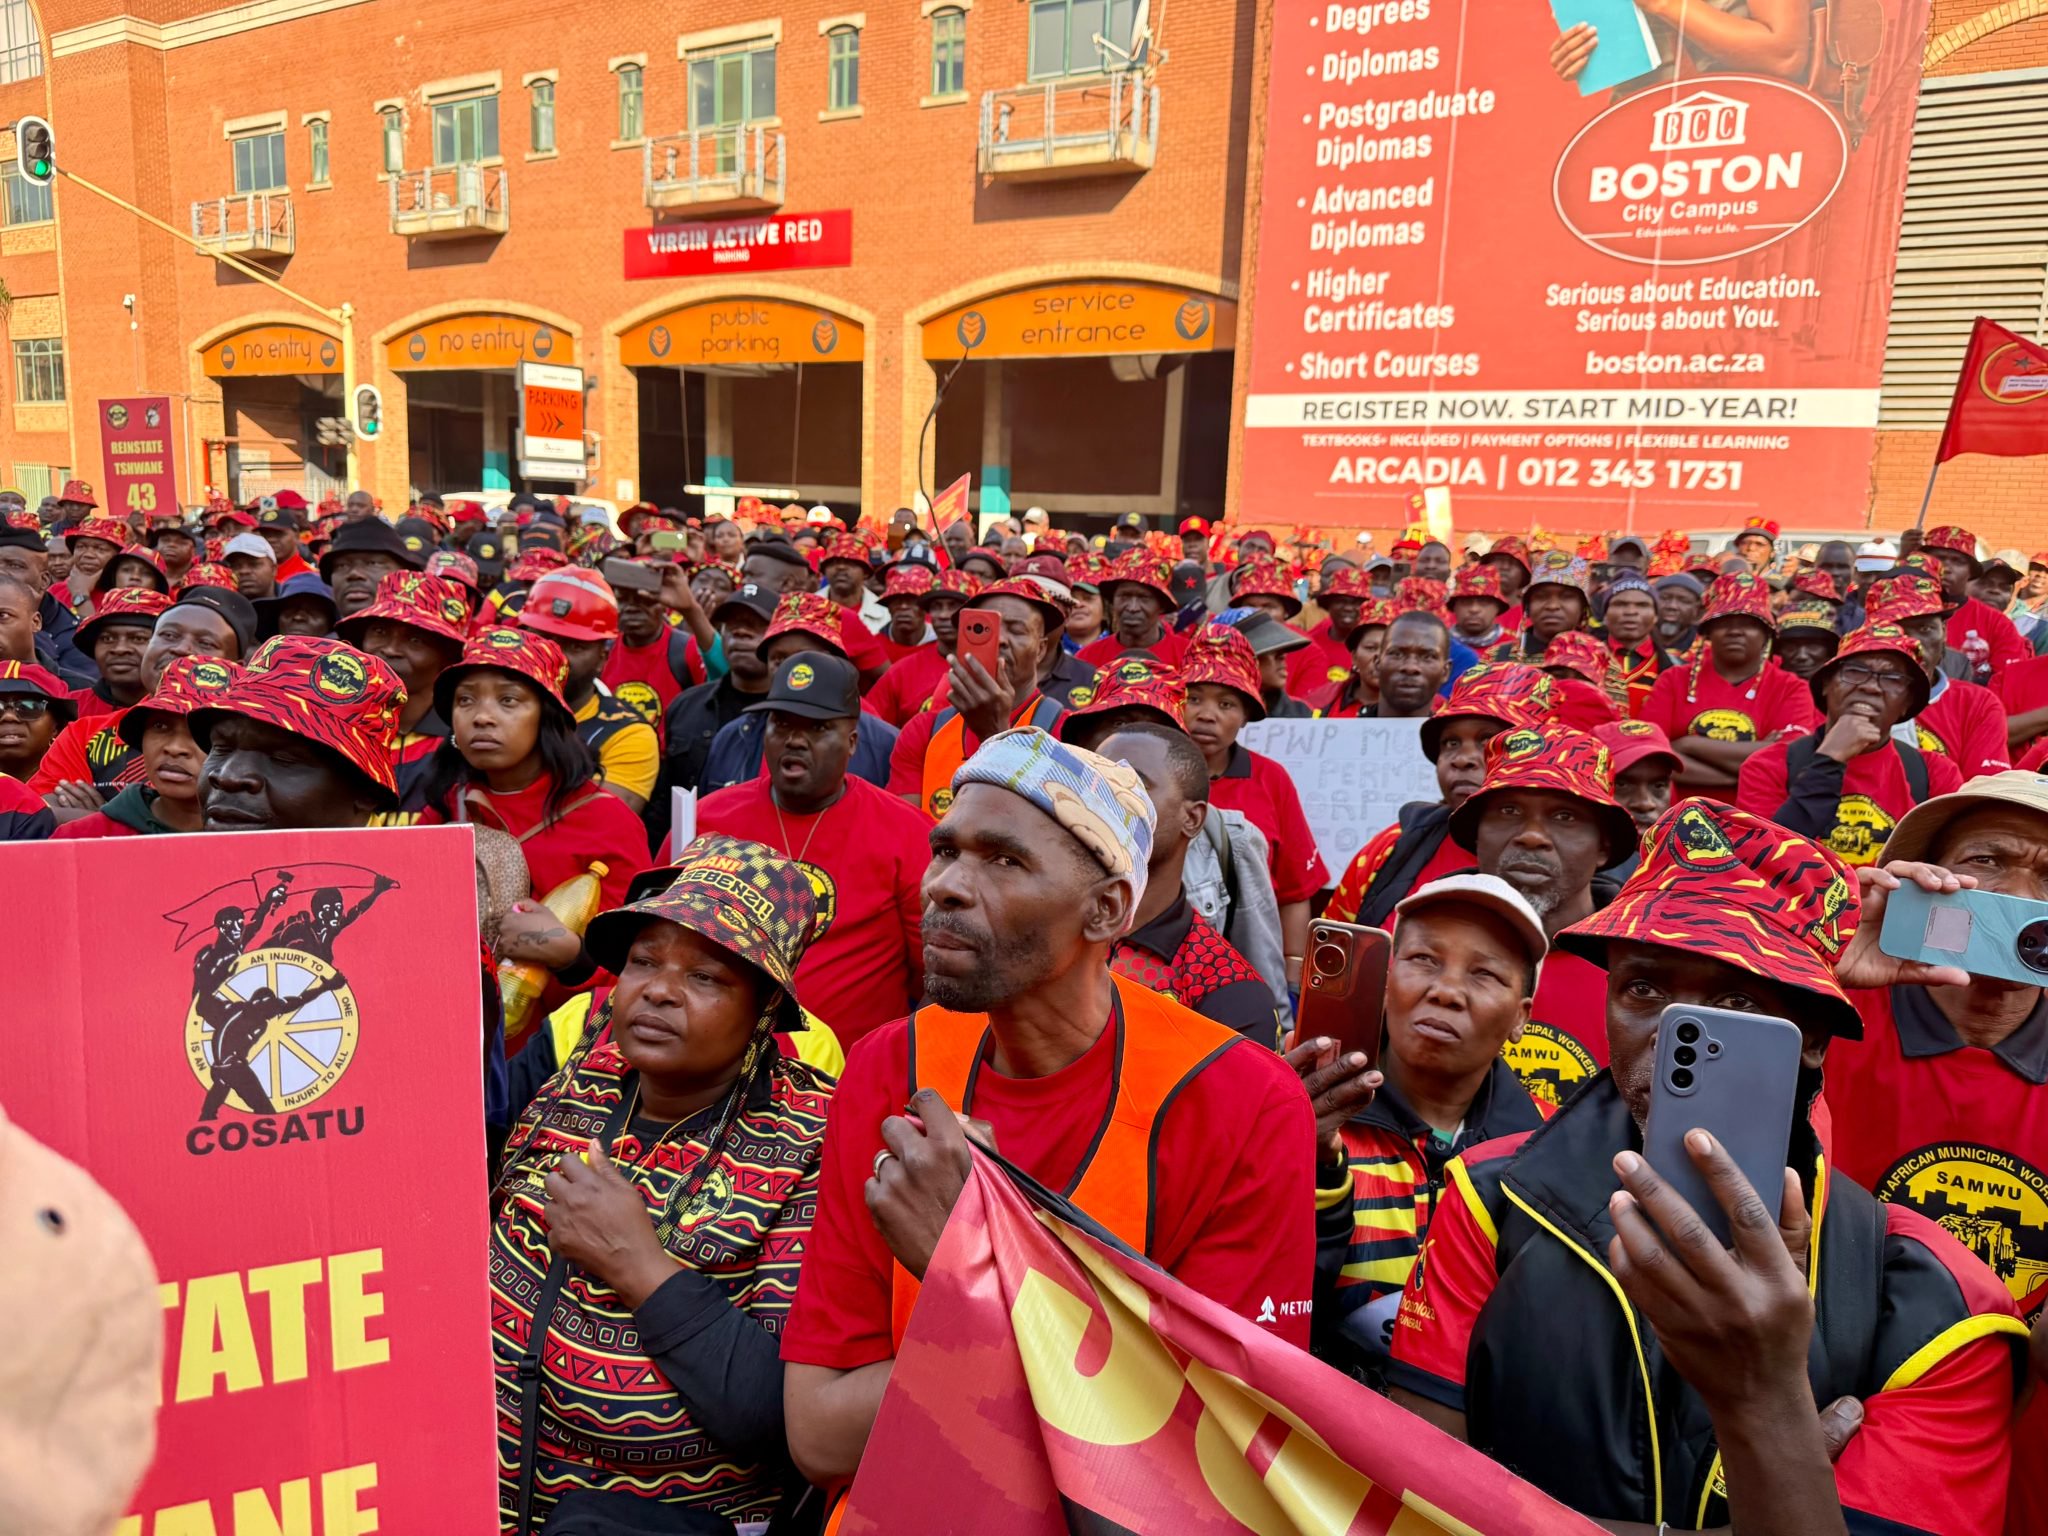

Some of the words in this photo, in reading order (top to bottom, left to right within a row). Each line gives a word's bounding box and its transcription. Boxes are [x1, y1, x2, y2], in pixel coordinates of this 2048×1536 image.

[1325, 0, 1431, 35] Degrees
[1322, 46, 1440, 86] Diplomas
[1319, 87, 1495, 131] Postgraduate
[1316, 134, 1433, 171] Diplomas
[1589, 151, 1803, 203] BOSTON
[1311, 176, 1434, 215] Advanced
[1622, 204, 1664, 224] City
[1670, 200, 1759, 220] Campus
[647, 229, 708, 254] VIRGIN
[713, 223, 780, 249] ACTIVE
[784, 219, 823, 244] RED
[1310, 219, 1425, 255] Diplomas
[713, 249, 750, 264] PARKING
[1306, 267, 1391, 303] Higher
[1545, 281, 1625, 307] Serious
[1630, 278, 1694, 304] about
[1699, 273, 1822, 301] Education.
[1033, 291, 1135, 314] service
[1304, 300, 1455, 333] Certificates
[710, 302, 769, 336] public
[1022, 320, 1146, 344] entrance
[1575, 307, 1656, 333] Serious
[1661, 305, 1727, 331] about
[1732, 304, 1779, 329] You.
[243, 343, 263, 360] no
[268, 333, 312, 367] entry
[439, 333, 464, 351] no
[471, 323, 525, 360] entry
[702, 330, 779, 359] parking
[1299, 351, 1368, 380] Short
[1373, 349, 1480, 379] Courses
[1585, 350, 1765, 375] boston.ac.za
[529, 390, 578, 409] PARKING
[1303, 399, 1429, 420] REGISTER
[1438, 398, 1514, 419] NOW.
[1523, 397, 1618, 419] START
[1627, 397, 1798, 419] MID-YEAR!
[111, 440, 164, 455] REINSTATE
[1389, 434, 1460, 447] INCLUDED
[1471, 434, 1541, 448] PAYMENT
[1544, 434, 1613, 448] OPTIONS
[1624, 434, 1699, 449] FLEXIBLE
[1702, 435, 1791, 450] LEARNING
[113, 461, 164, 475] TSHWANE
[1328, 457, 1487, 486] ARCADIA
[1517, 457, 1580, 487] 012
[1587, 458, 1656, 489] 343
[1665, 460, 1744, 491] 1731
[127, 482, 157, 511] 43
[249, 953, 265, 966] AN
[269, 952, 308, 965] INJURY
[311, 960, 324, 973] TO
[341, 996, 353, 1017] ONE
[190, 1041, 200, 1053] IS
[335, 1050, 349, 1070] ALL
[194, 1056, 207, 1072] AN
[321, 1071, 335, 1085] TO
[284, 1085, 320, 1107] INJURY
[185, 1106, 365, 1156] COSATU
[1886, 1150, 1936, 1192] AFRICAN
[1937, 1146, 2016, 1173] MUNICIPAL
[1936, 1171, 2022, 1201] SAMWU
[158, 1247, 390, 1406] ATE
